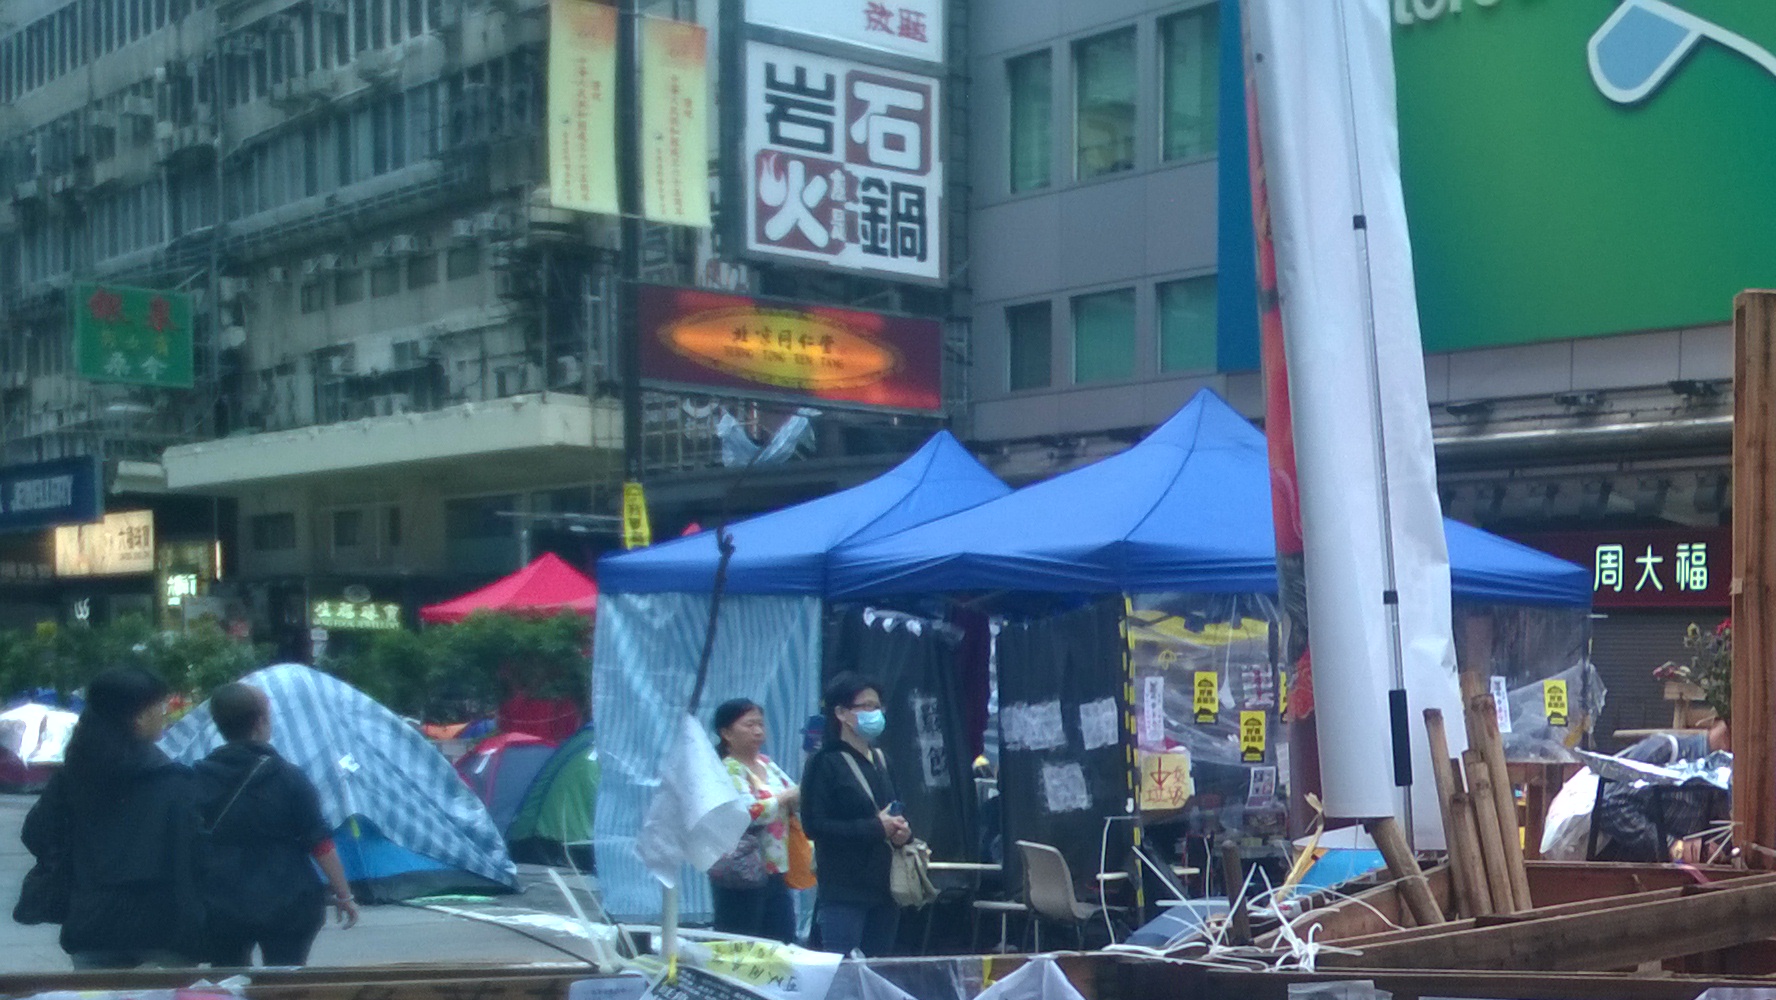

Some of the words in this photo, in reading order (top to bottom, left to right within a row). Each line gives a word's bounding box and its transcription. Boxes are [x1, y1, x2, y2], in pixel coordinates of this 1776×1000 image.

[765, 62, 926, 172] 岩石
[757, 153, 928, 263] 火鍋
[1595, 542, 1708, 592] 周大福
